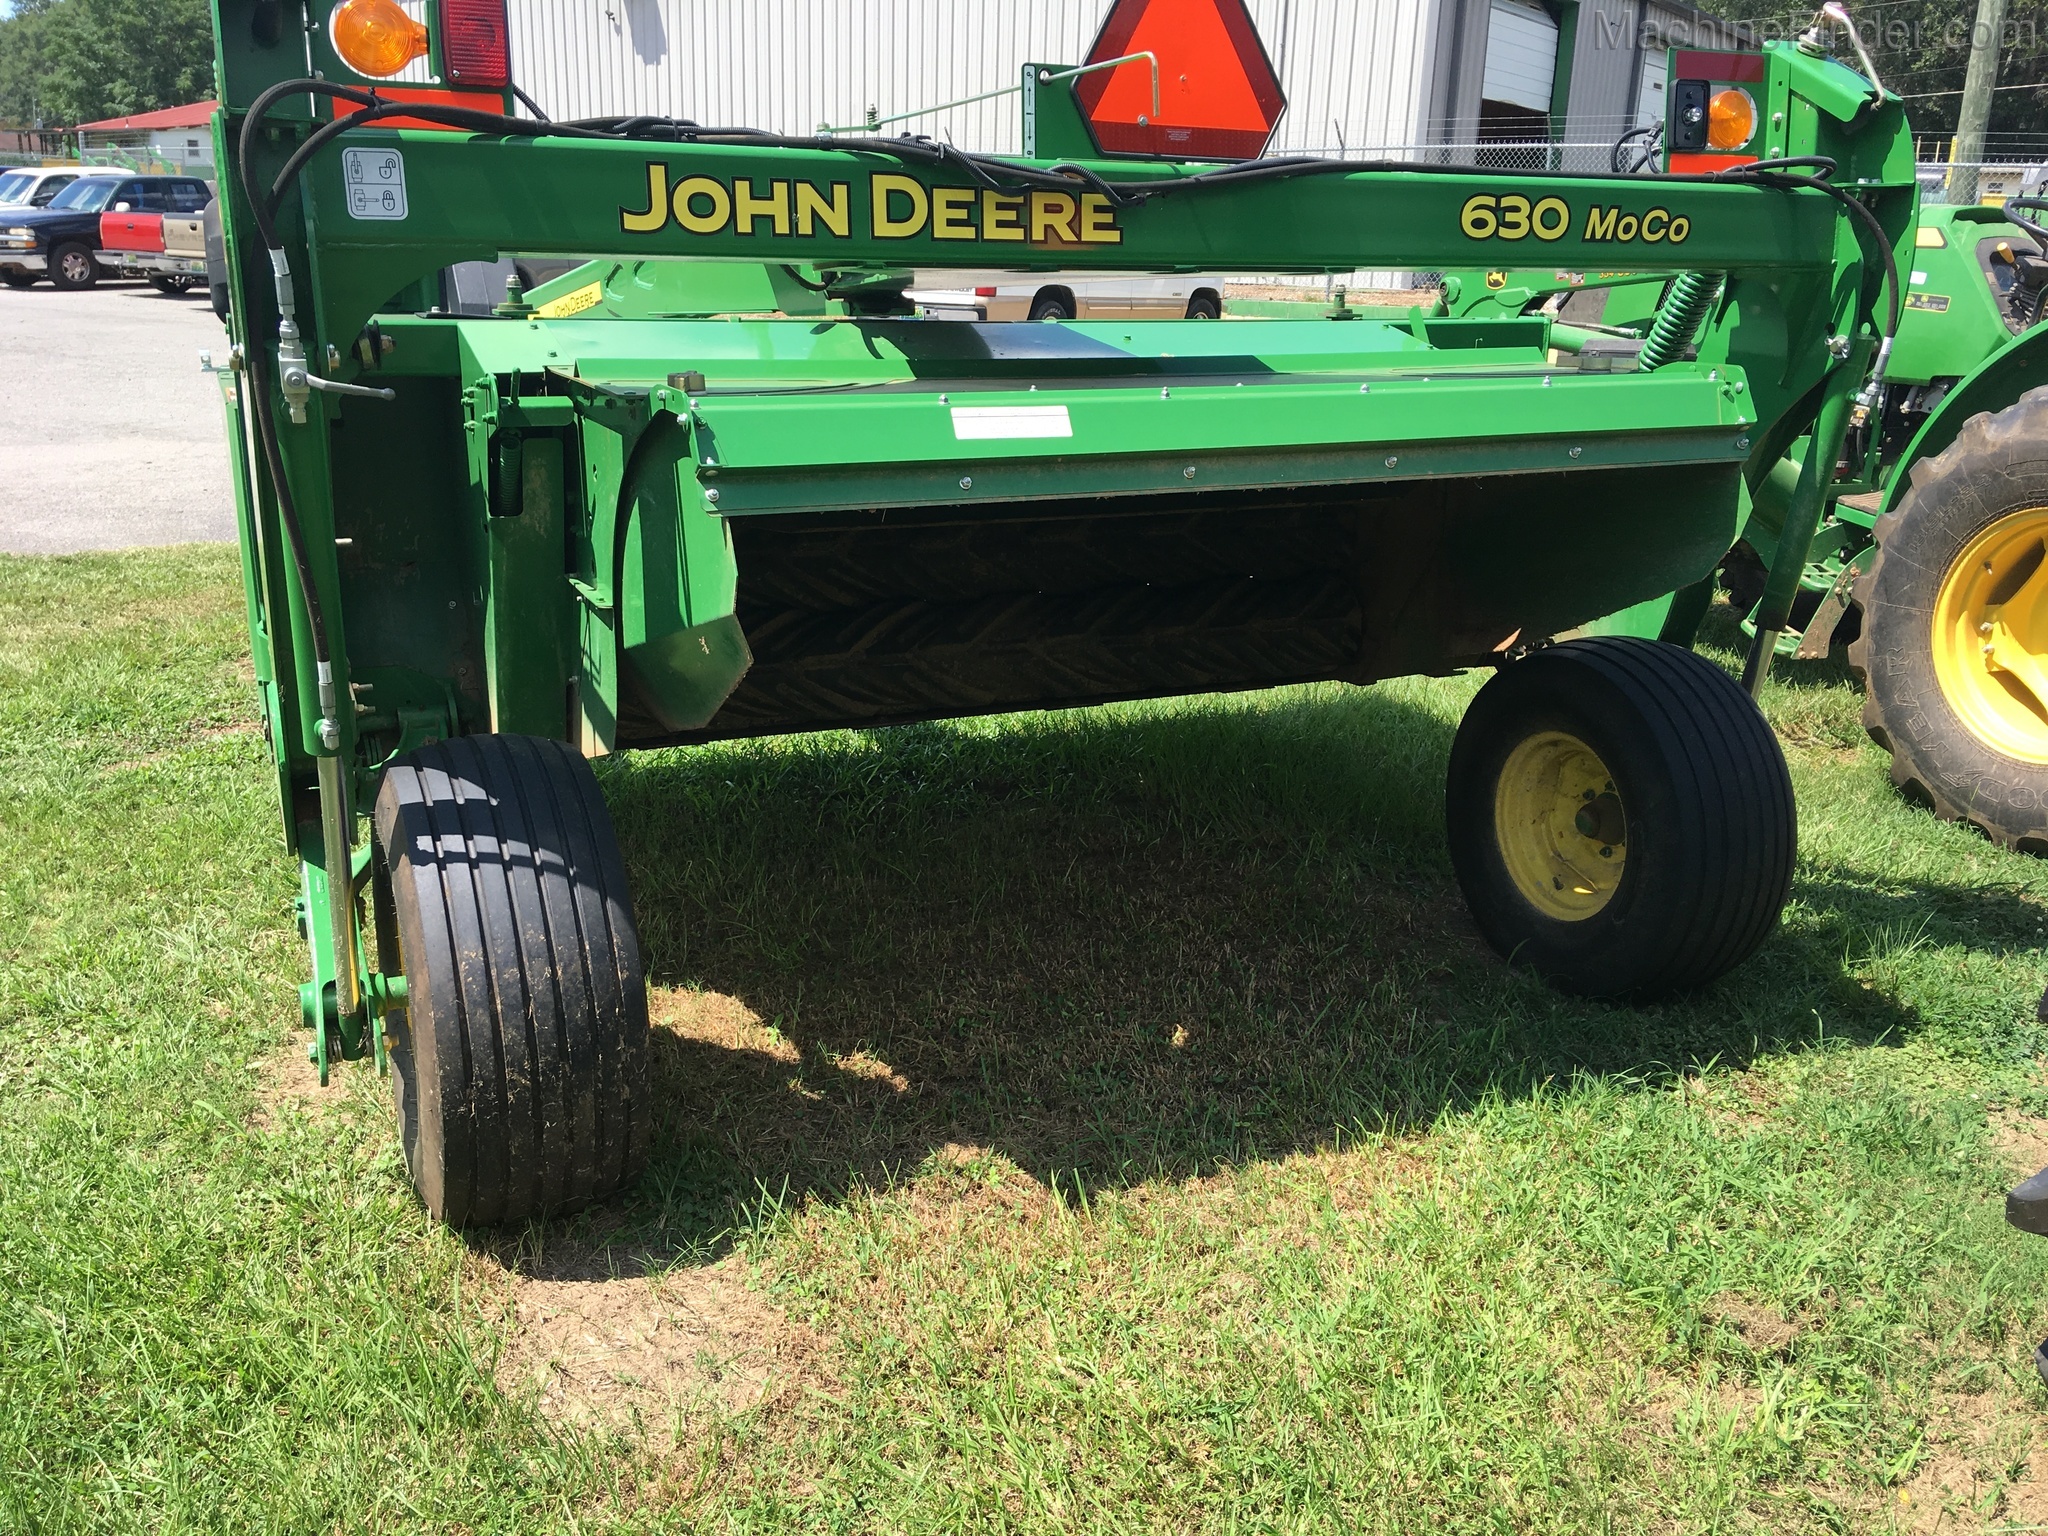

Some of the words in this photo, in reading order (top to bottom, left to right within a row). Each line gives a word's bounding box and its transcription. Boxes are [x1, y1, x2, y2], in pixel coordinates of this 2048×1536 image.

[620, 162, 851, 239] JOHN
[869, 170, 1124, 245] DEERE
[1460, 193, 1571, 242] 630
[1583, 205, 1691, 243] MoCo
